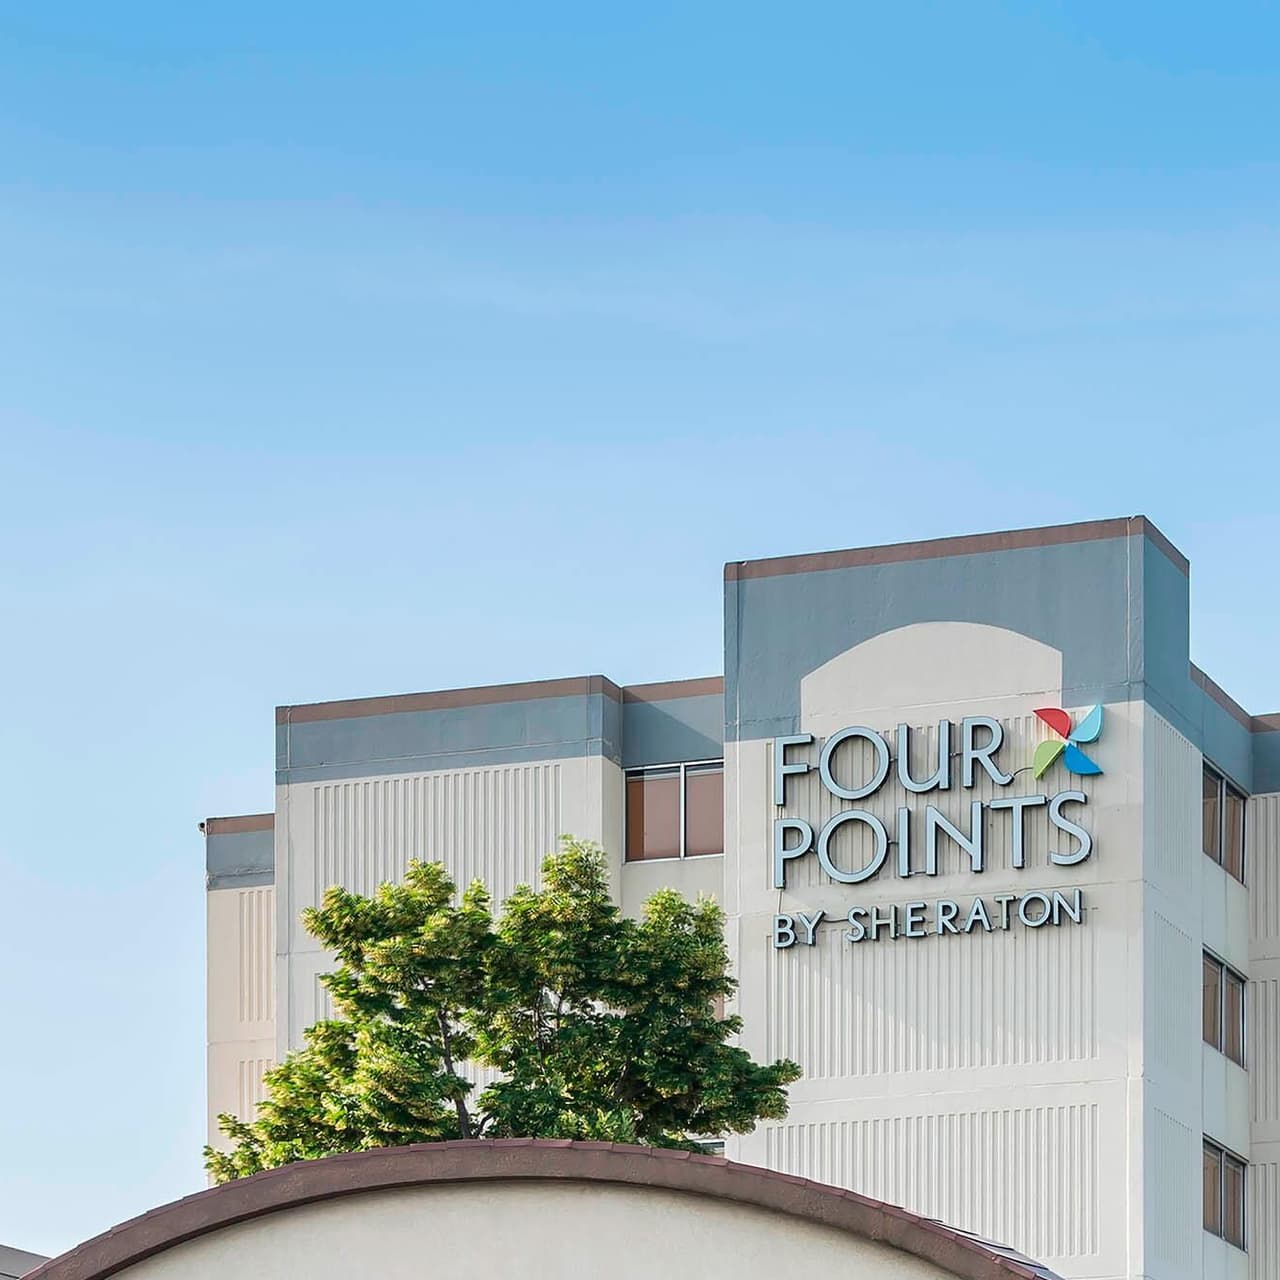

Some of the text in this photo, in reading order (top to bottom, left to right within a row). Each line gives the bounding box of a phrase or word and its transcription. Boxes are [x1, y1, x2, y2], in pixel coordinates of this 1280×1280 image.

[773, 715, 1015, 806] FOUR
[773, 790, 1093, 889] POINTS
[773, 888, 1082, 949] BY SHERATON
